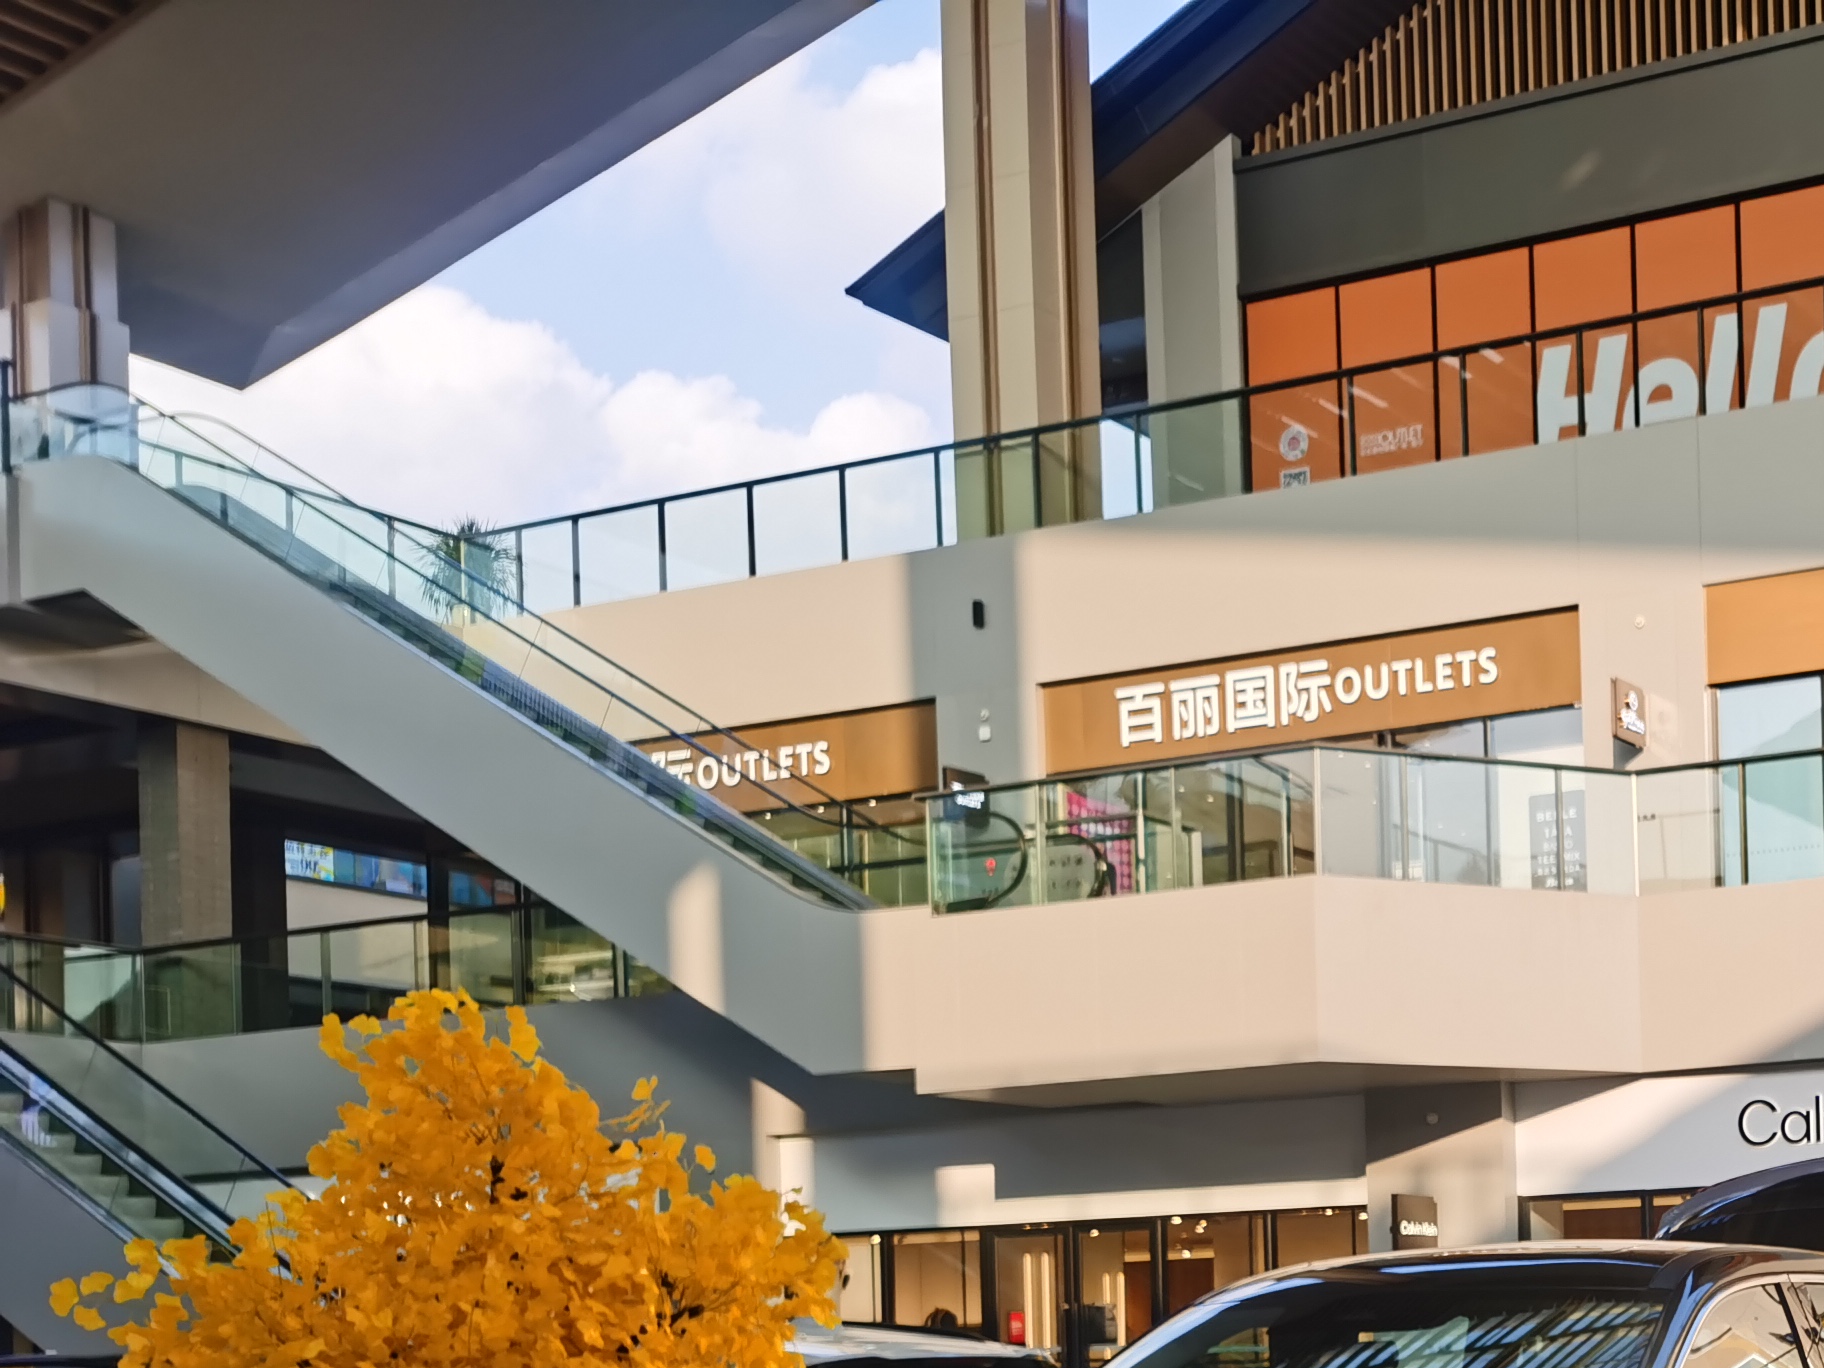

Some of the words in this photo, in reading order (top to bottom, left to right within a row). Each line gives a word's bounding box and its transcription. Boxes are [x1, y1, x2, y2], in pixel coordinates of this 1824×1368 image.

[1113, 658, 1333, 748] 百丽国际
[1333, 646, 1499, 705] OUTLETS
[696, 740, 831, 790] OUTLETS
